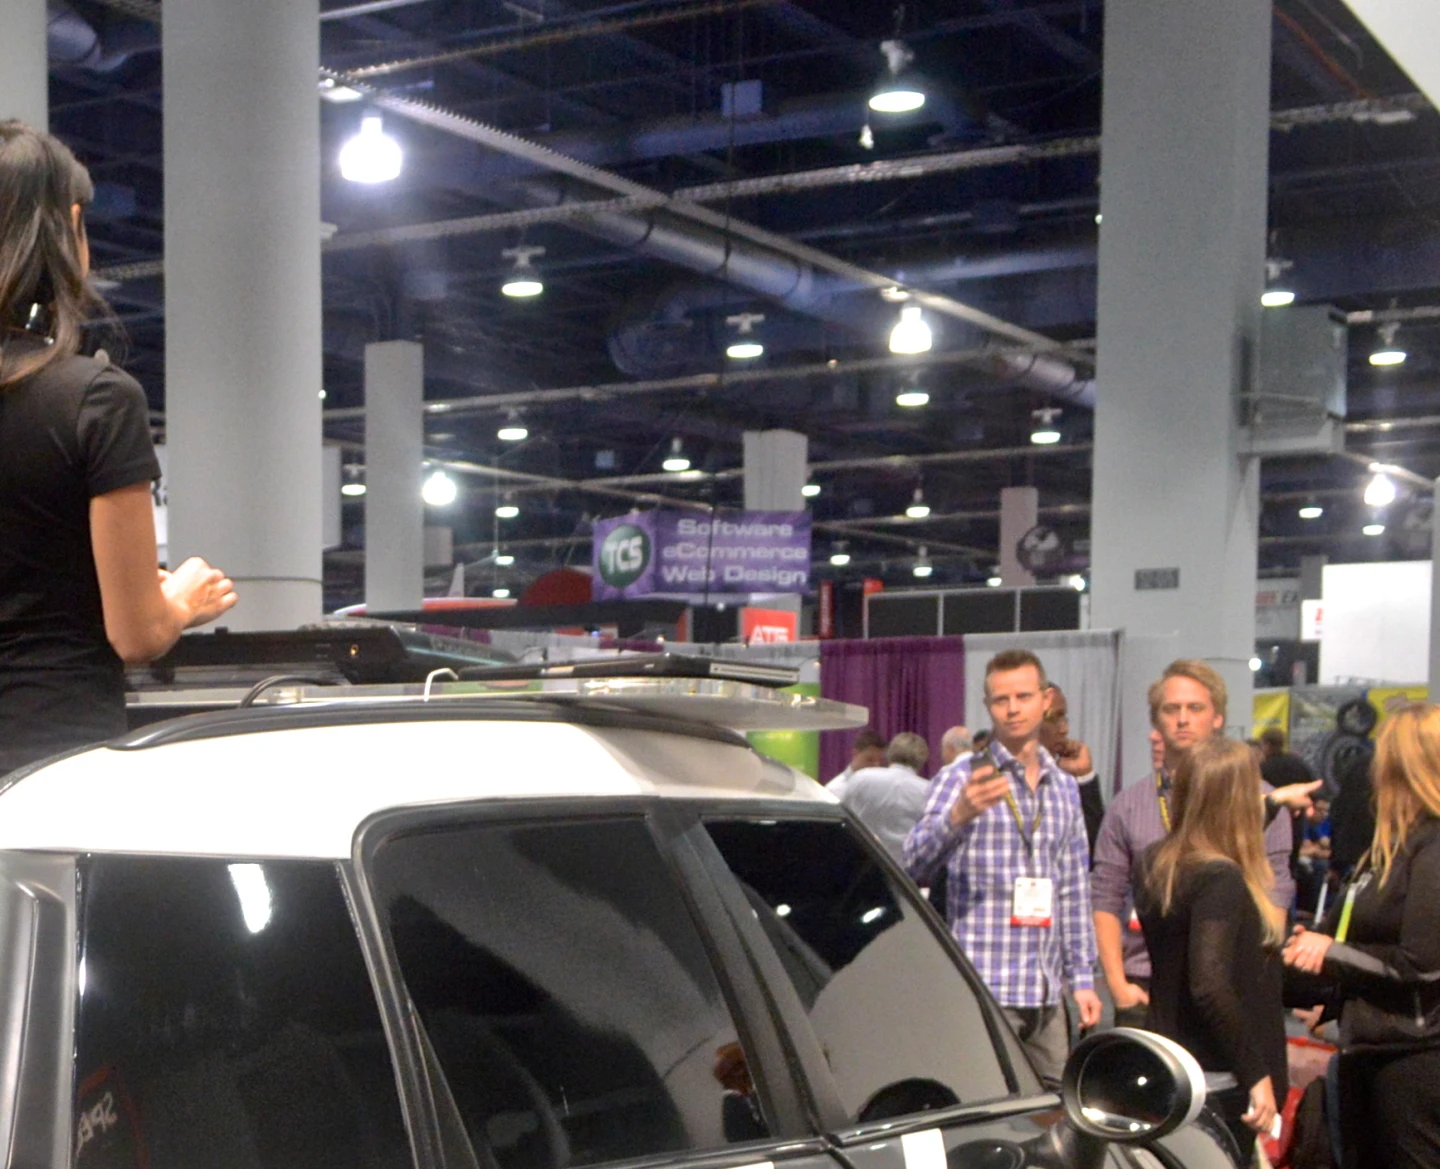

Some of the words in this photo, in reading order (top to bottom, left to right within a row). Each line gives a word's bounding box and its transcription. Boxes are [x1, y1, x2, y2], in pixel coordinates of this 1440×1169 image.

[677, 518, 792, 536] Software
[603, 536, 643, 576] TCS
[662, 541, 808, 560] eCommerce
[661, 565, 715, 584] Web
[724, 565, 807, 586] Design
